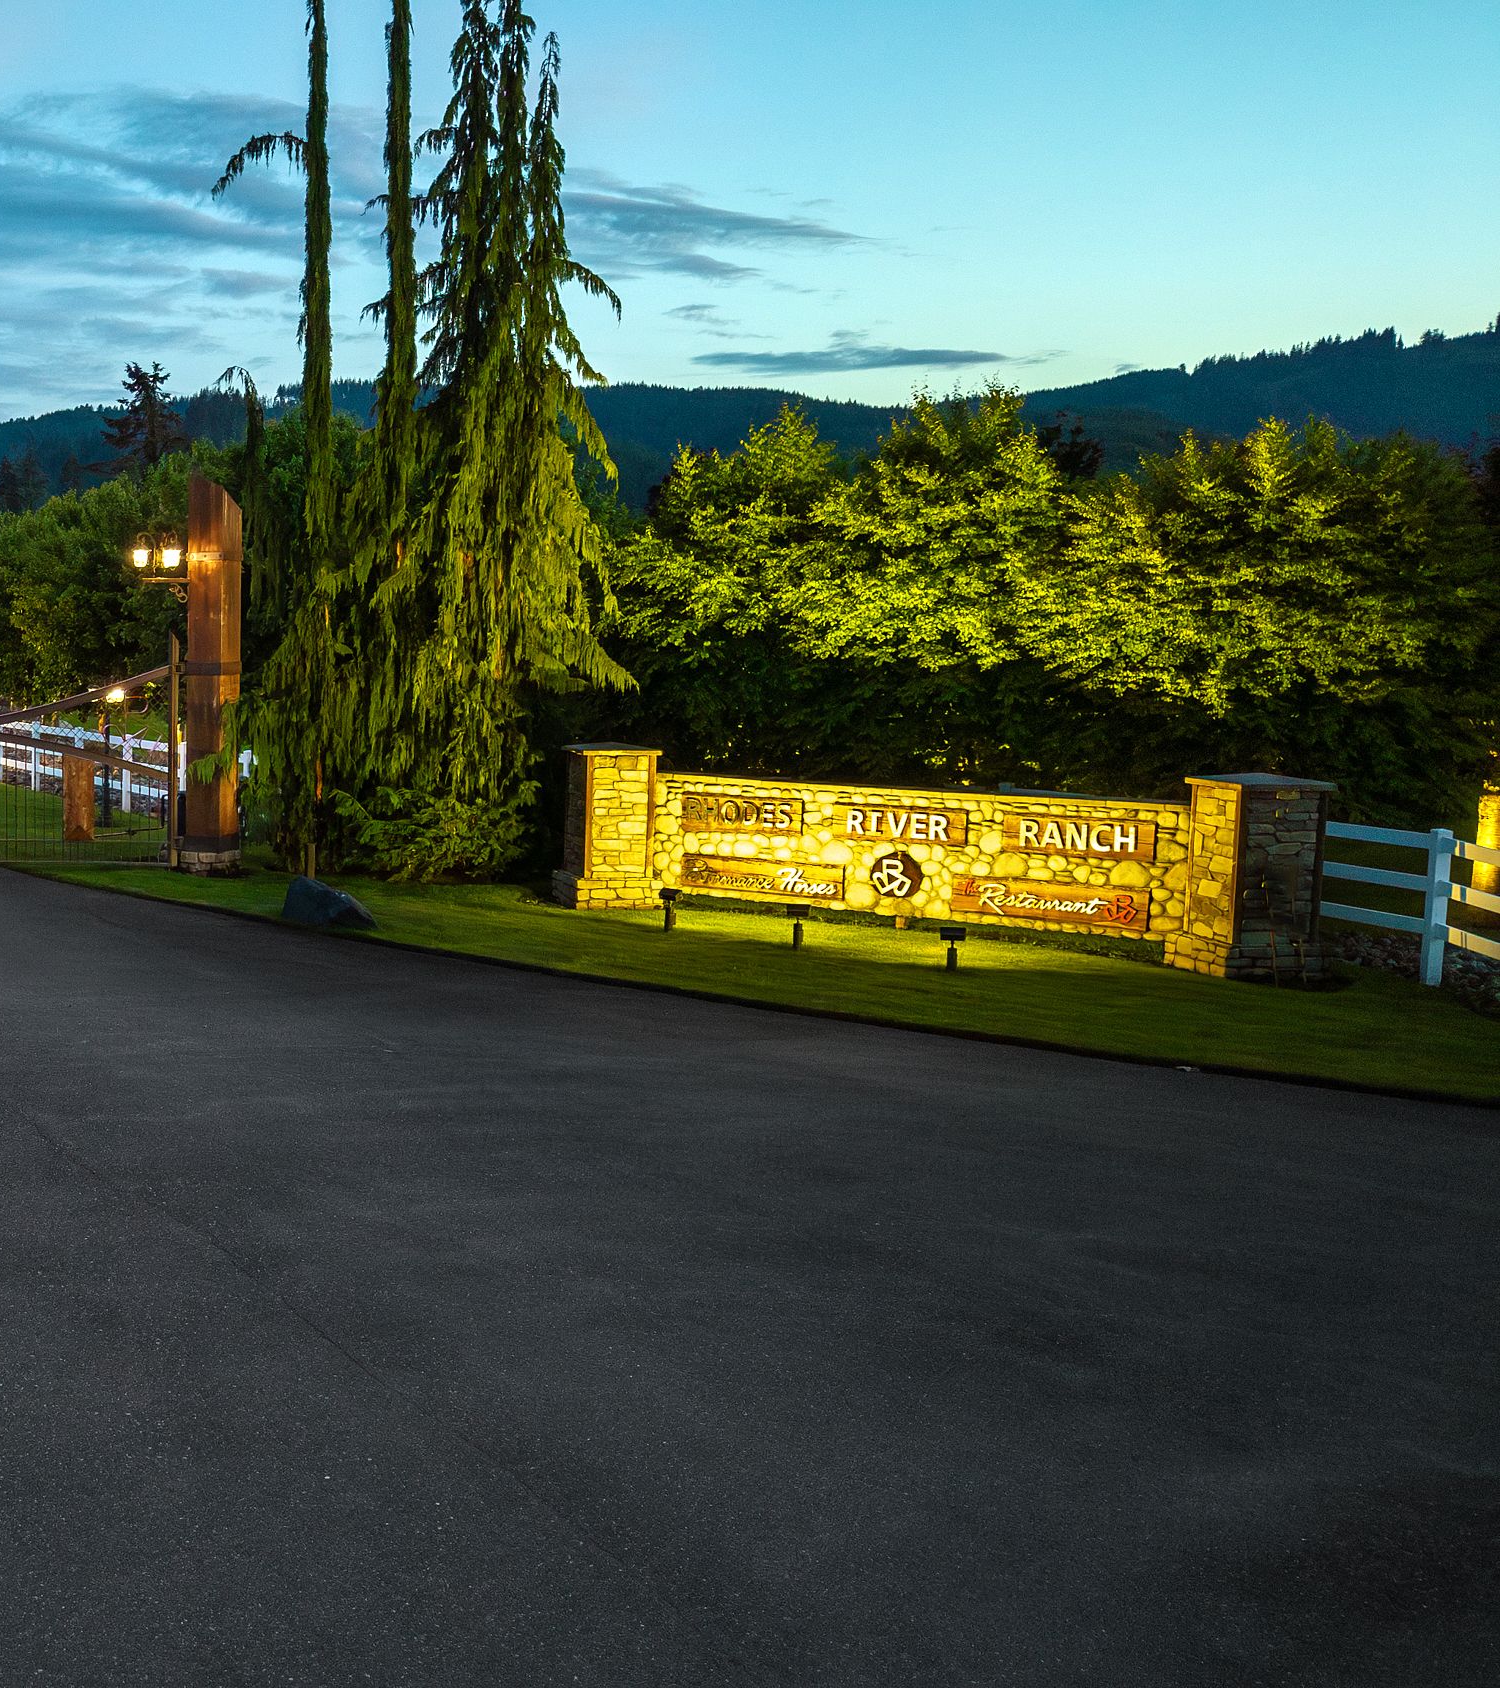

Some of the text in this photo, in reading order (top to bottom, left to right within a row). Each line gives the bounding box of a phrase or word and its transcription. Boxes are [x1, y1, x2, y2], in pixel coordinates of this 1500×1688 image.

[685, 797, 1138, 853] RHODES RIVER RANCH
[682, 858, 838, 895] Pormance Horses
[978, 883, 1111, 915] Restaurant
